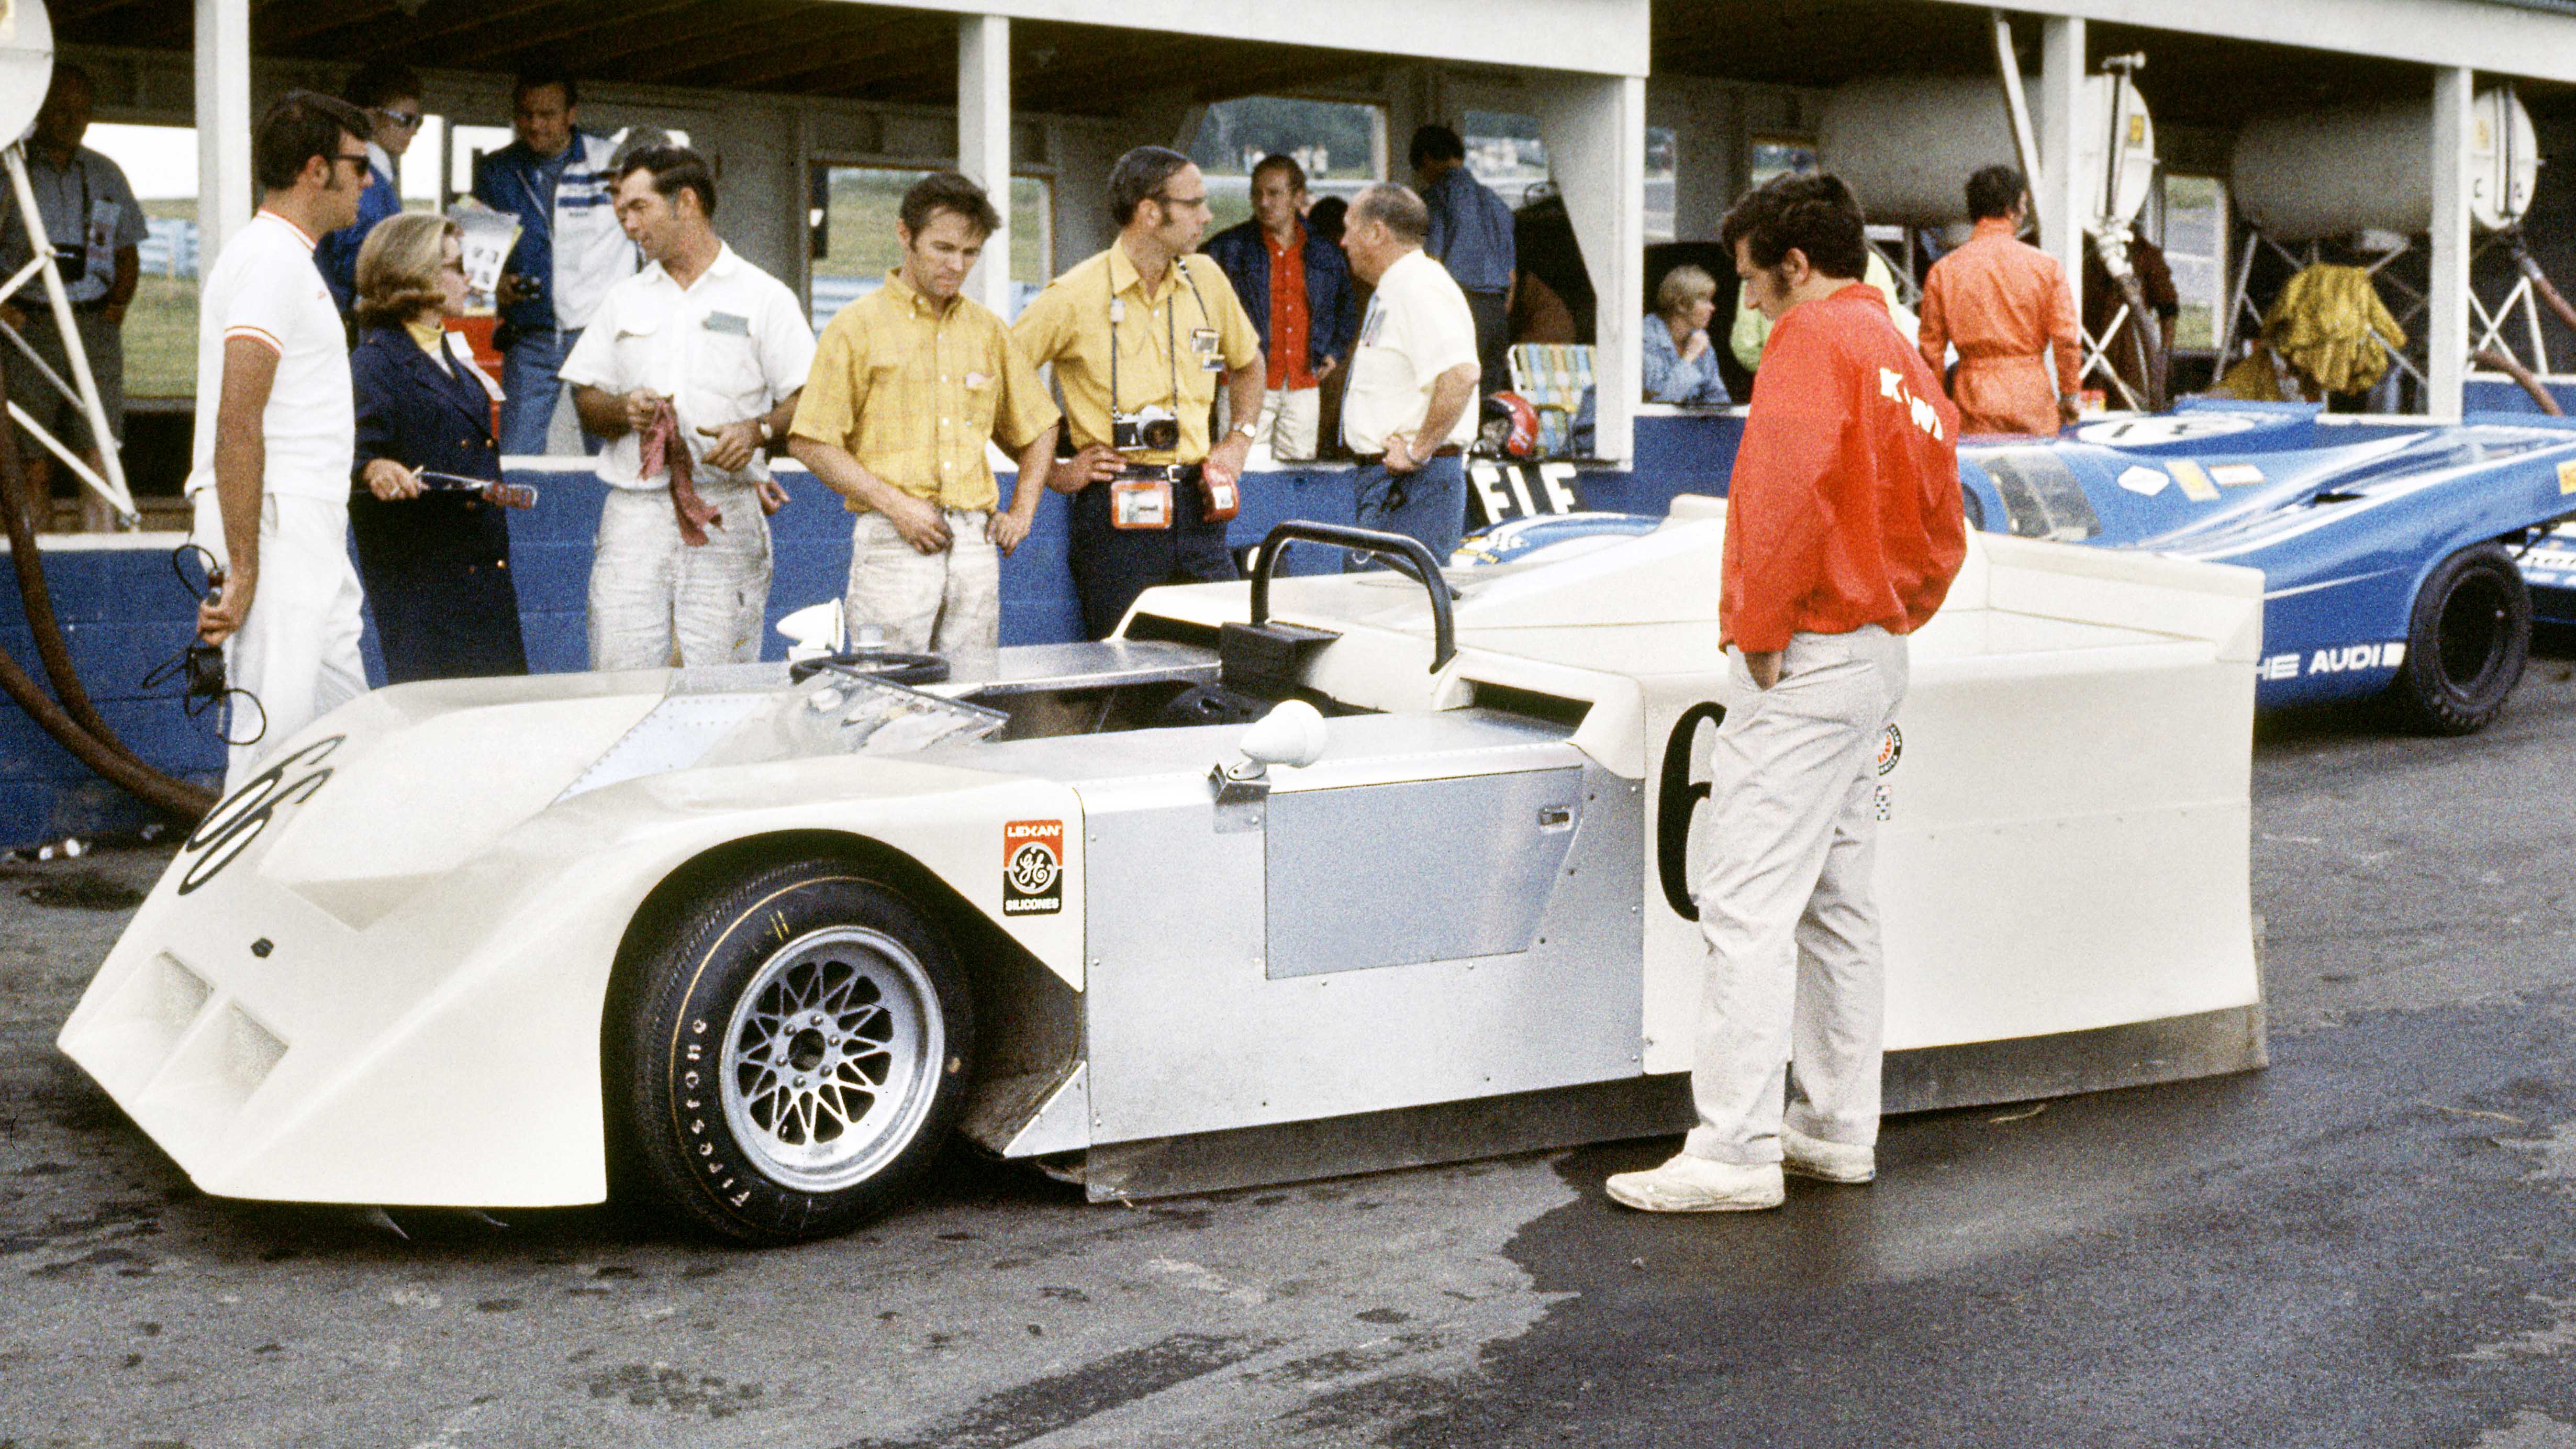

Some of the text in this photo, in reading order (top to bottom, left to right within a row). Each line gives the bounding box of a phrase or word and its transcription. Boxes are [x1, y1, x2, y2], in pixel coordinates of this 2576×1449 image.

[2309, 644, 2381, 674] AUDI
[177, 733, 347, 896] 66
[1007, 825, 1059, 837] LEXAN
[1006, 898, 1059, 911] SILICONES
